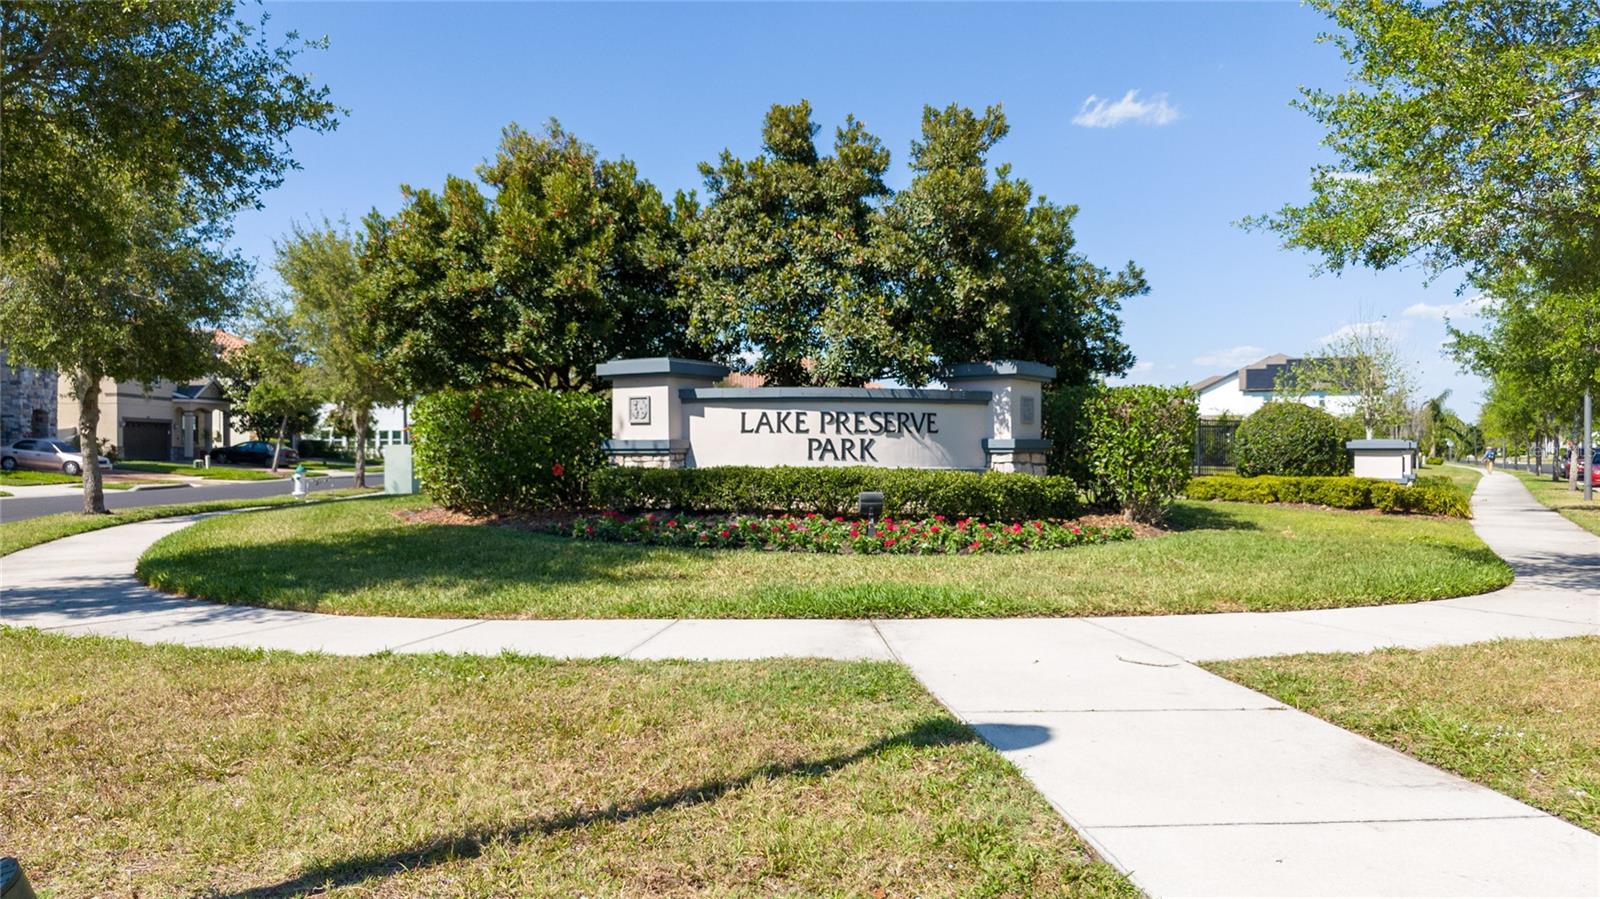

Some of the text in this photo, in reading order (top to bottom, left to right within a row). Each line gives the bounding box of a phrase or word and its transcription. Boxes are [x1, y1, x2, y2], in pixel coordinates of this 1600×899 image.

[740, 411, 939, 435] LAKE PRESERVE
[807, 438, 877, 461] PARK
